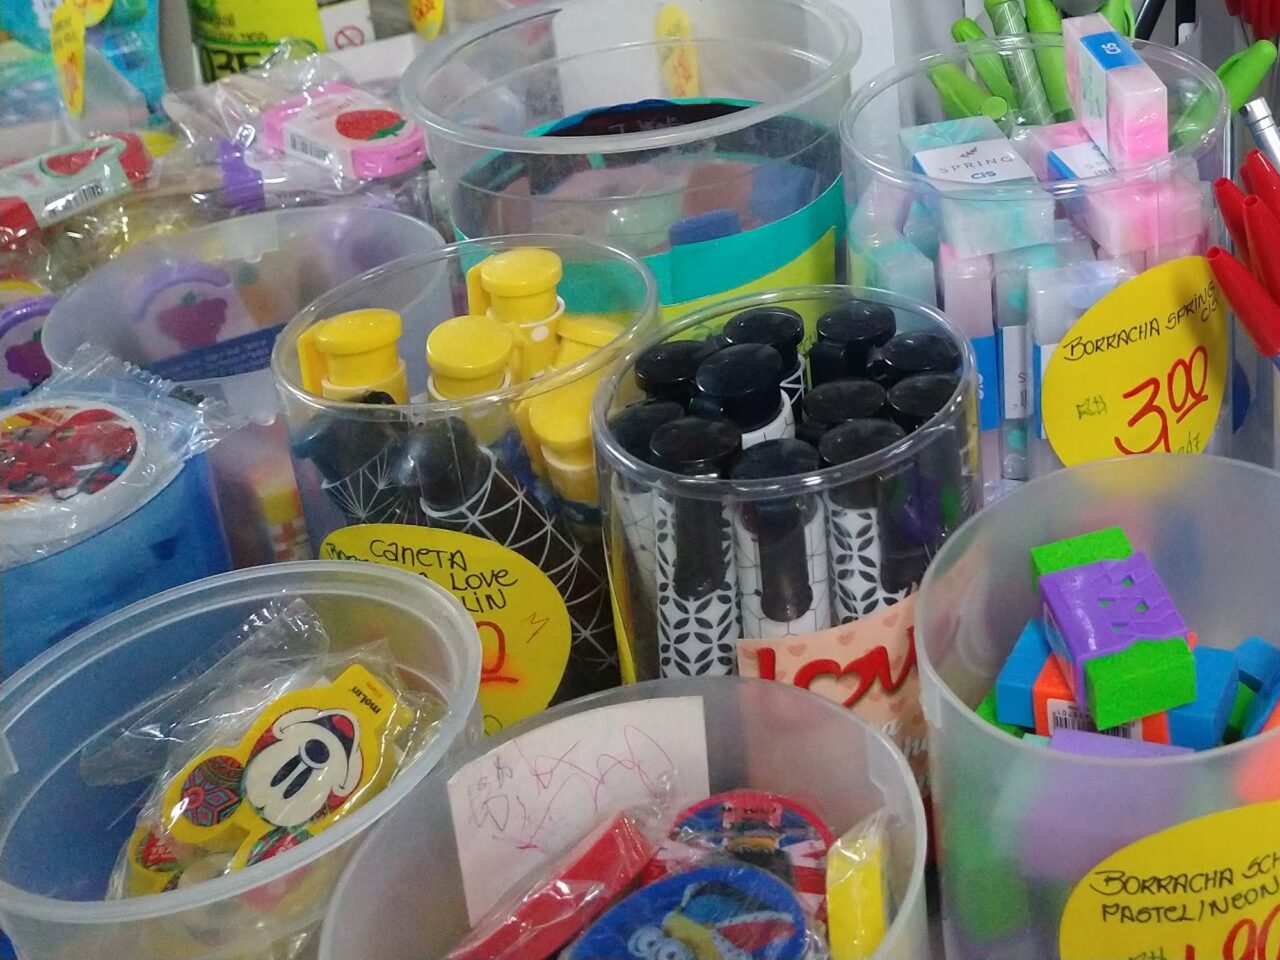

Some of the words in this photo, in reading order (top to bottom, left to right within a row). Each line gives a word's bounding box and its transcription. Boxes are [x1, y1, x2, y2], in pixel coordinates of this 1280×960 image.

[938, 155, 1014, 174] SPRING
[1064, 321, 1161, 361] BORRACHA
[1089, 867, 1234, 896] BORRACHA
